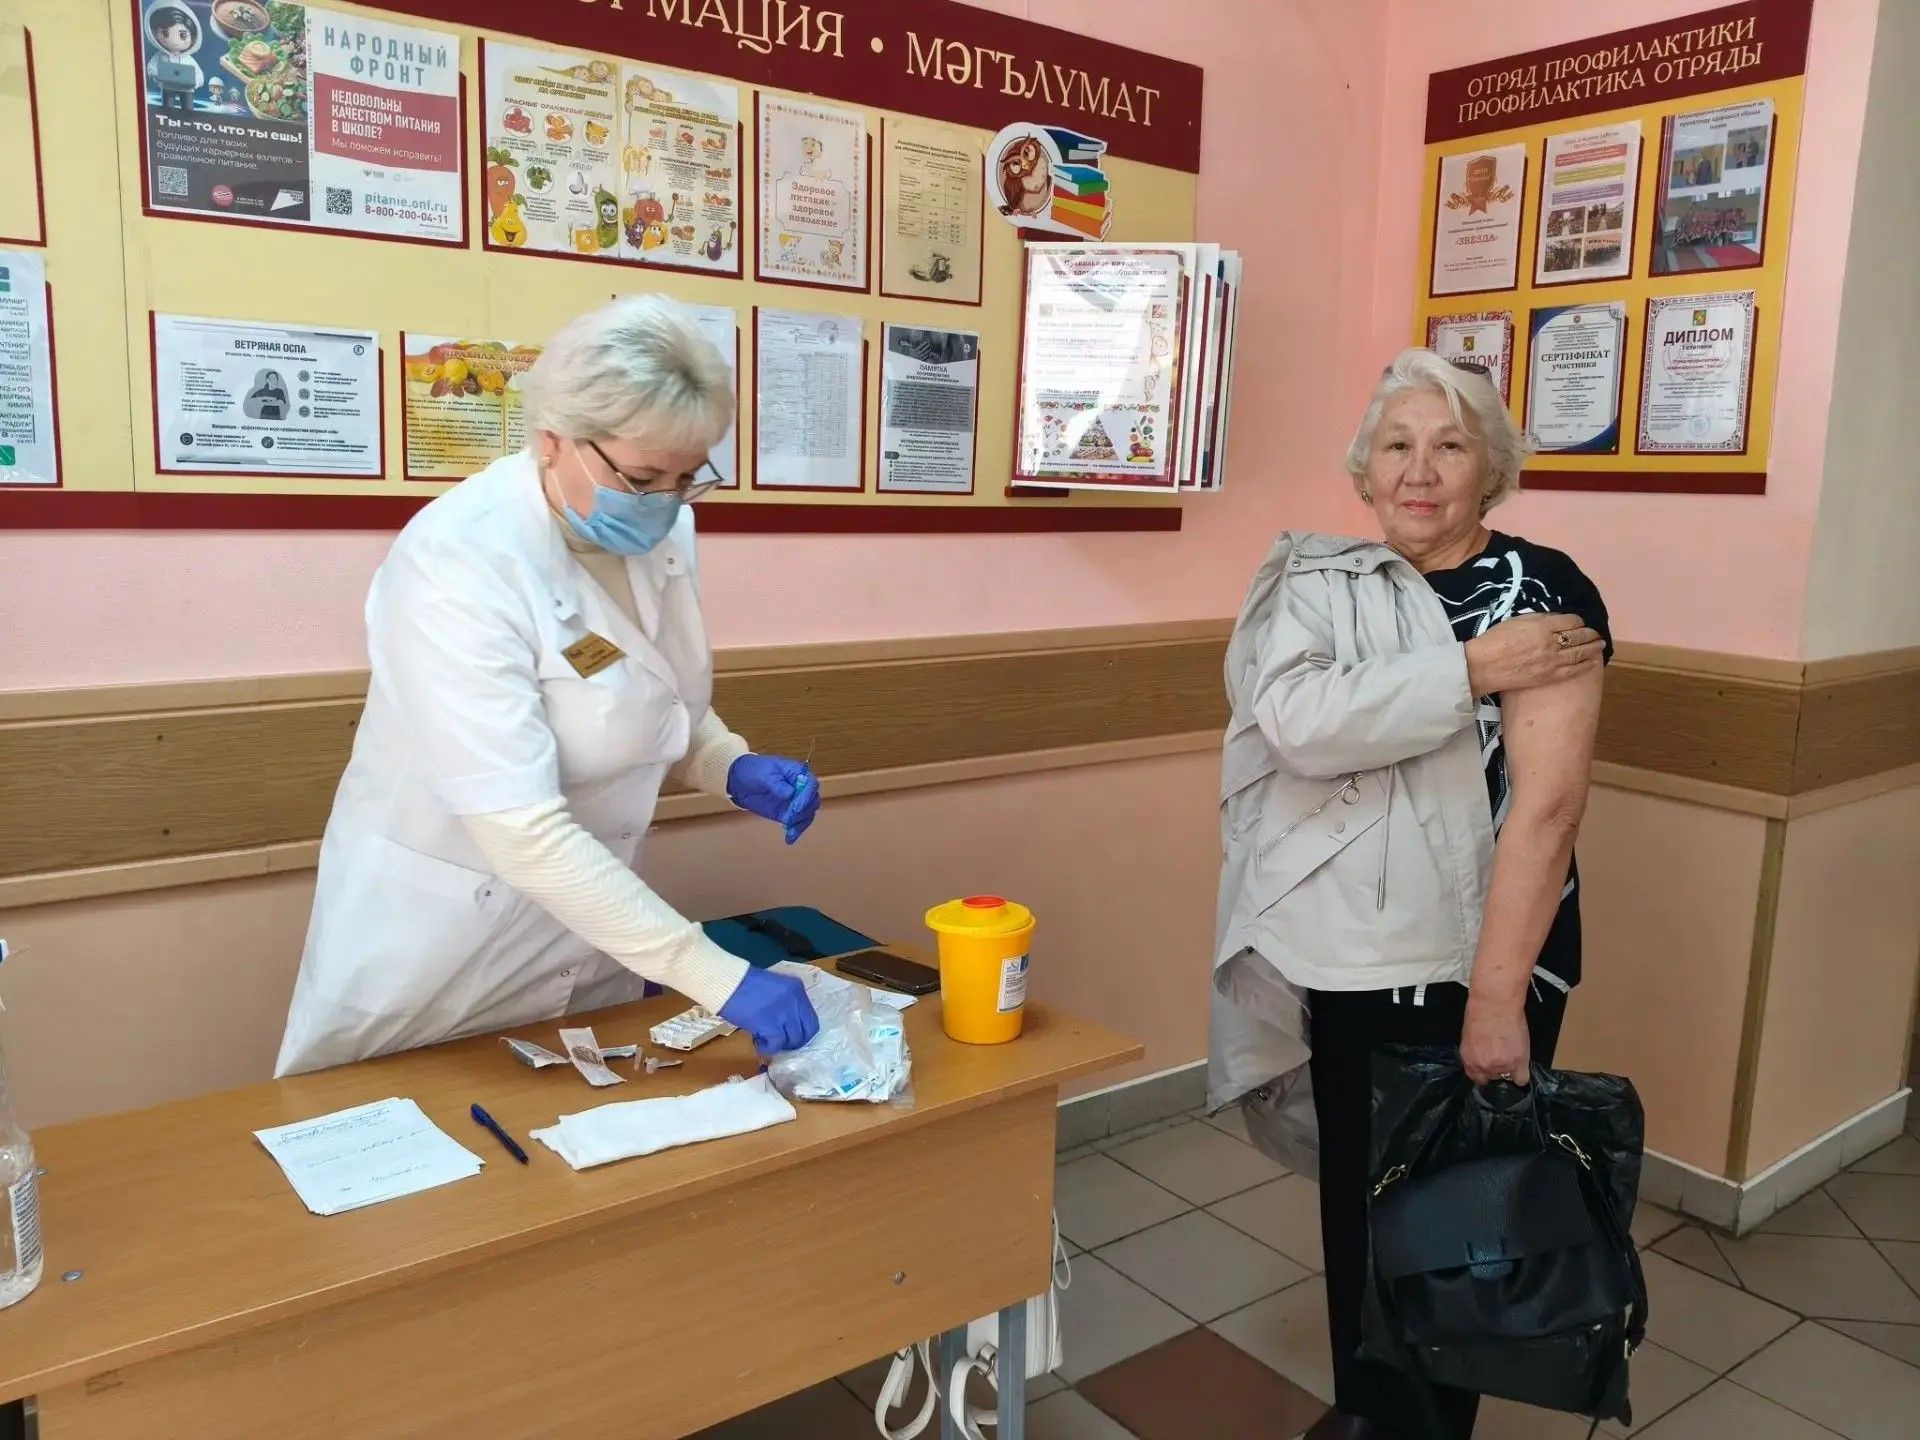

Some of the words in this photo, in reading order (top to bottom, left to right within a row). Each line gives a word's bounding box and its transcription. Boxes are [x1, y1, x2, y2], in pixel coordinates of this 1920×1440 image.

[325, 26, 447, 68] НАРОДНЫЙ
[1468, 65, 1536, 99] ОТРЯД
[1544, 17, 1756, 84] ПРОФИЛАКТИКИ
[350, 55, 424, 86] ФРОНТ
[1458, 70, 1645, 124] ПРОФИЛАКТИКА
[1654, 43, 1763, 83] ОТРЯДЫ
[331, 89, 402, 112] НЕДОВОЛЬНЫ
[331, 104, 392, 126] КАЧЕСТВОМ
[395, 115, 440, 134] ПИТАНИЯ
[155, 114, 181, 127] Ты
[193, 121, 216, 133] то,
[219, 126, 245, 136] что
[247, 128, 268, 139] ты
[270, 132, 303, 144] ешь!
[331, 120, 339, 132] В
[342, 121, 382, 139] ШКОЛЕ?
[155, 130, 198, 142] Топливо
[200, 136, 218, 145] для
[220, 138, 248, 148] твоих
[332, 138, 346, 149] Мы
[350, 142, 391, 156] поможем
[156, 140, 200, 154] будущих
[202, 147, 254, 160] карьерных
[156, 151, 216, 166] правильное
[792, 181, 835, 196] Здоровое
[364, 192, 448, 213] pitanie.onf.ru
[791, 194, 830, 205] питание
[364, 205, 449, 224] 8-800-200-04-11
[792, 204, 834, 216] здоровое
[789, 214, 838, 227] поколение
[234, 339, 281, 352] ВЕТРЯНАЯ
[283, 343, 307, 353] ОСПА
[1663, 327, 1734, 347] ДИПЛОМ
[1443, 354, 1498, 367] ИПЛОМ
[1541, 350, 1611, 362] СЕРТИФИКАТ
[1552, 361, 1597, 372] участника
